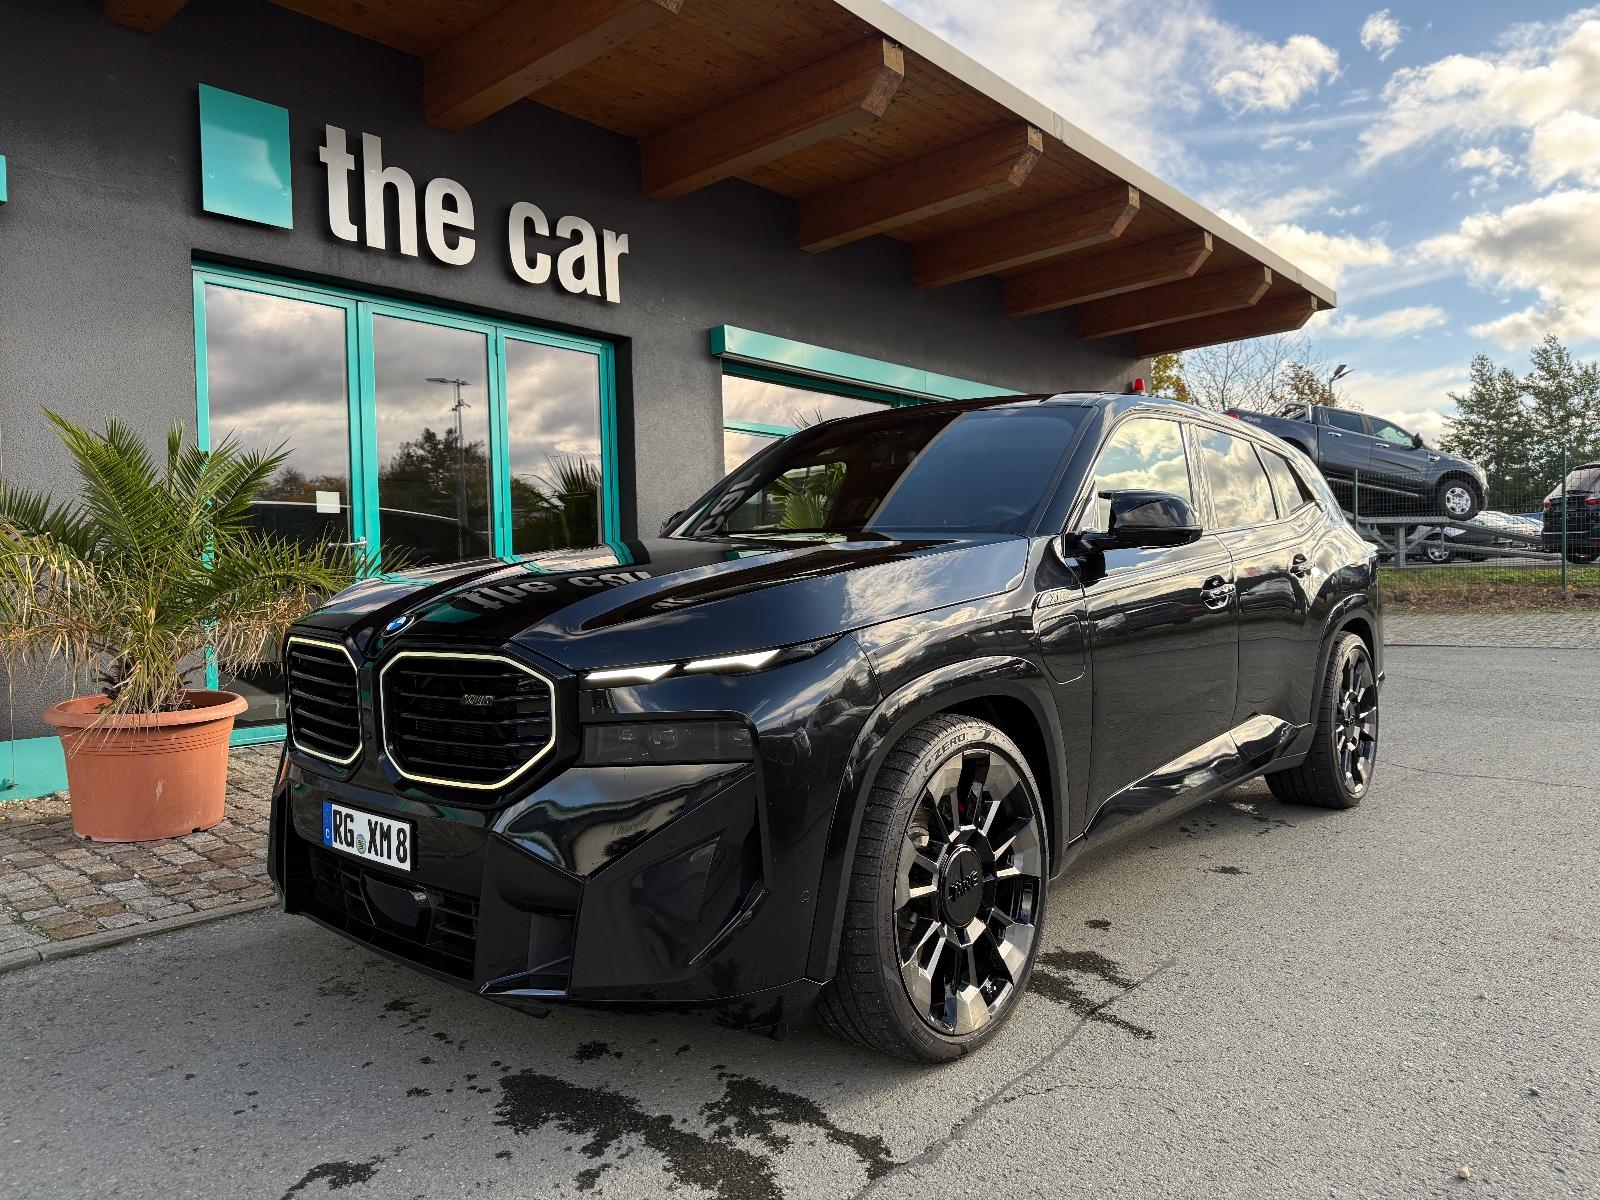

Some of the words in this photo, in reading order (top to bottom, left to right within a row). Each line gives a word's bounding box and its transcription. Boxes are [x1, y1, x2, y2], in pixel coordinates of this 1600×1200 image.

[319, 123, 476, 266] the
[508, 201, 629, 304] car
[332, 809, 355, 848] RG
[395, 827, 408, 864] 8
